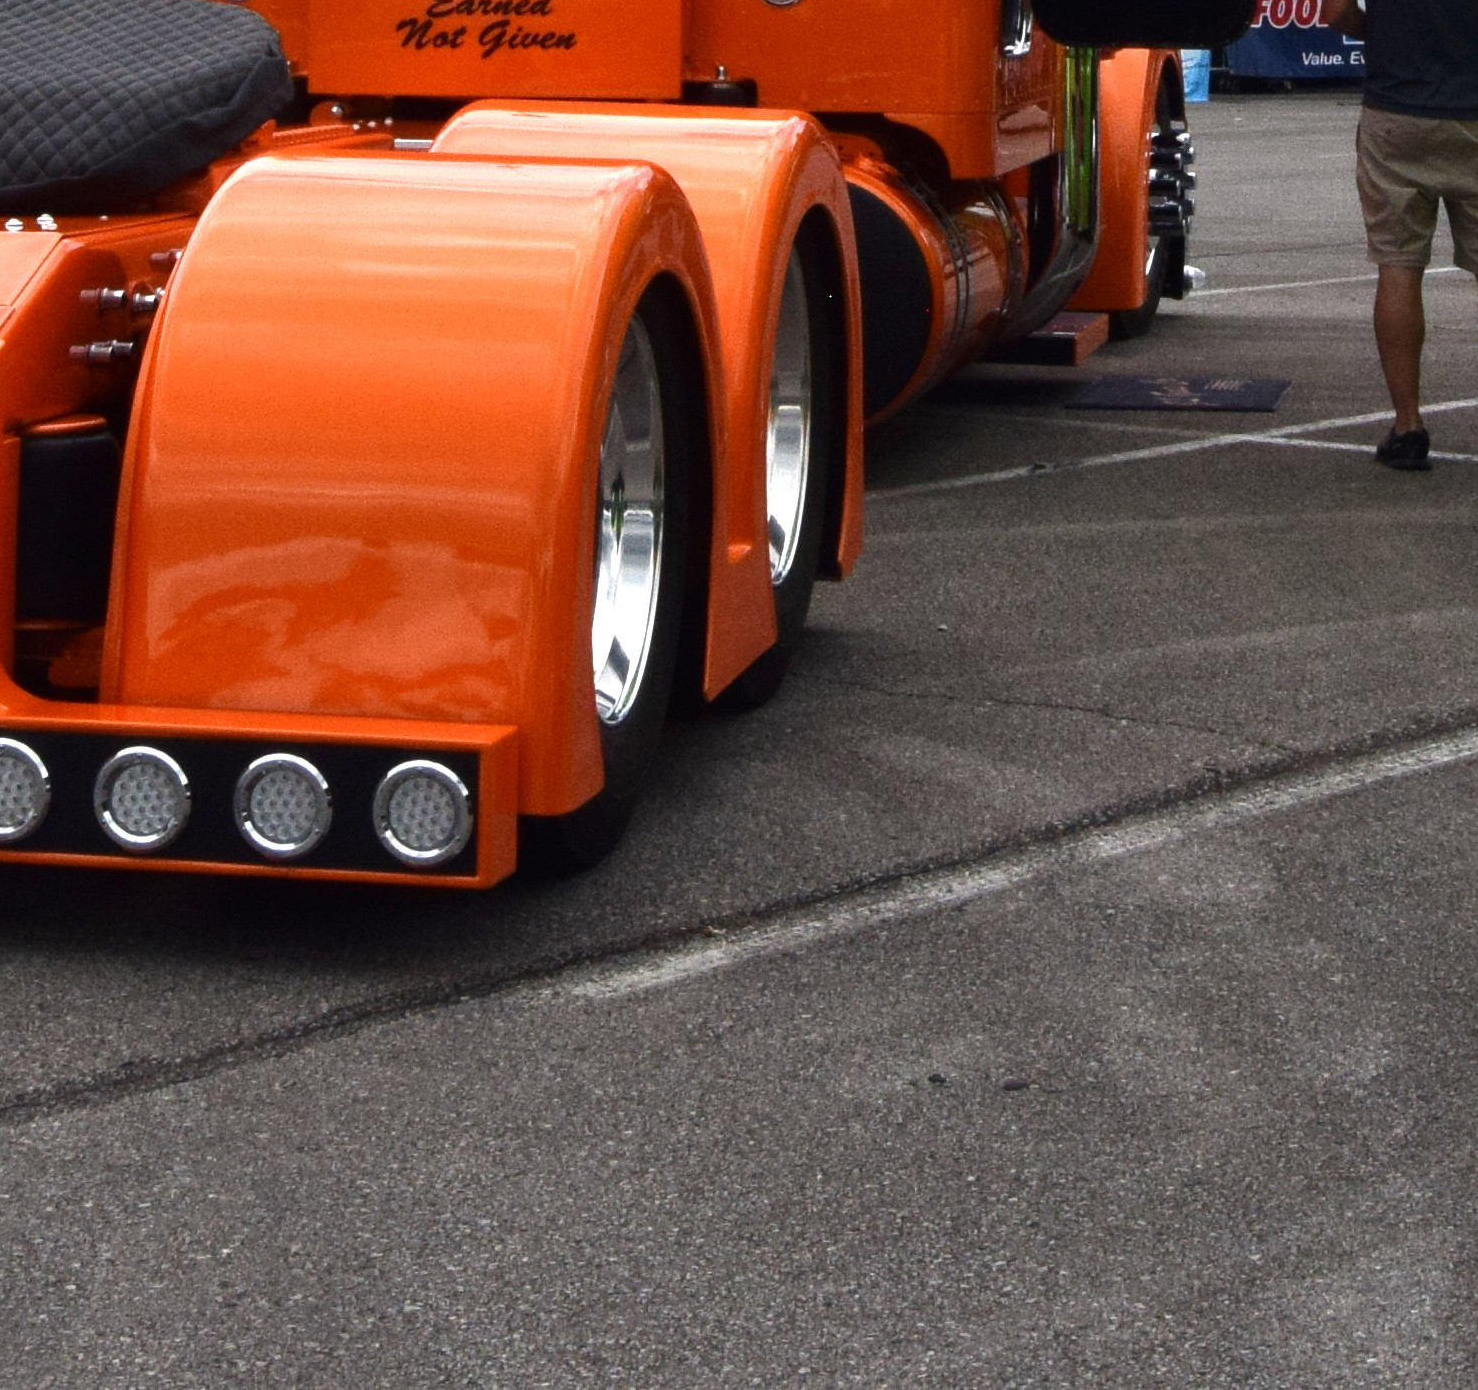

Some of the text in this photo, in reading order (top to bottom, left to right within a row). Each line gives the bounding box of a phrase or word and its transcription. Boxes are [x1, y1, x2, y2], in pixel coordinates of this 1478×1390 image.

[395, 18, 578, 60] Not Given
[1302, 51, 1345, 66] Value.
